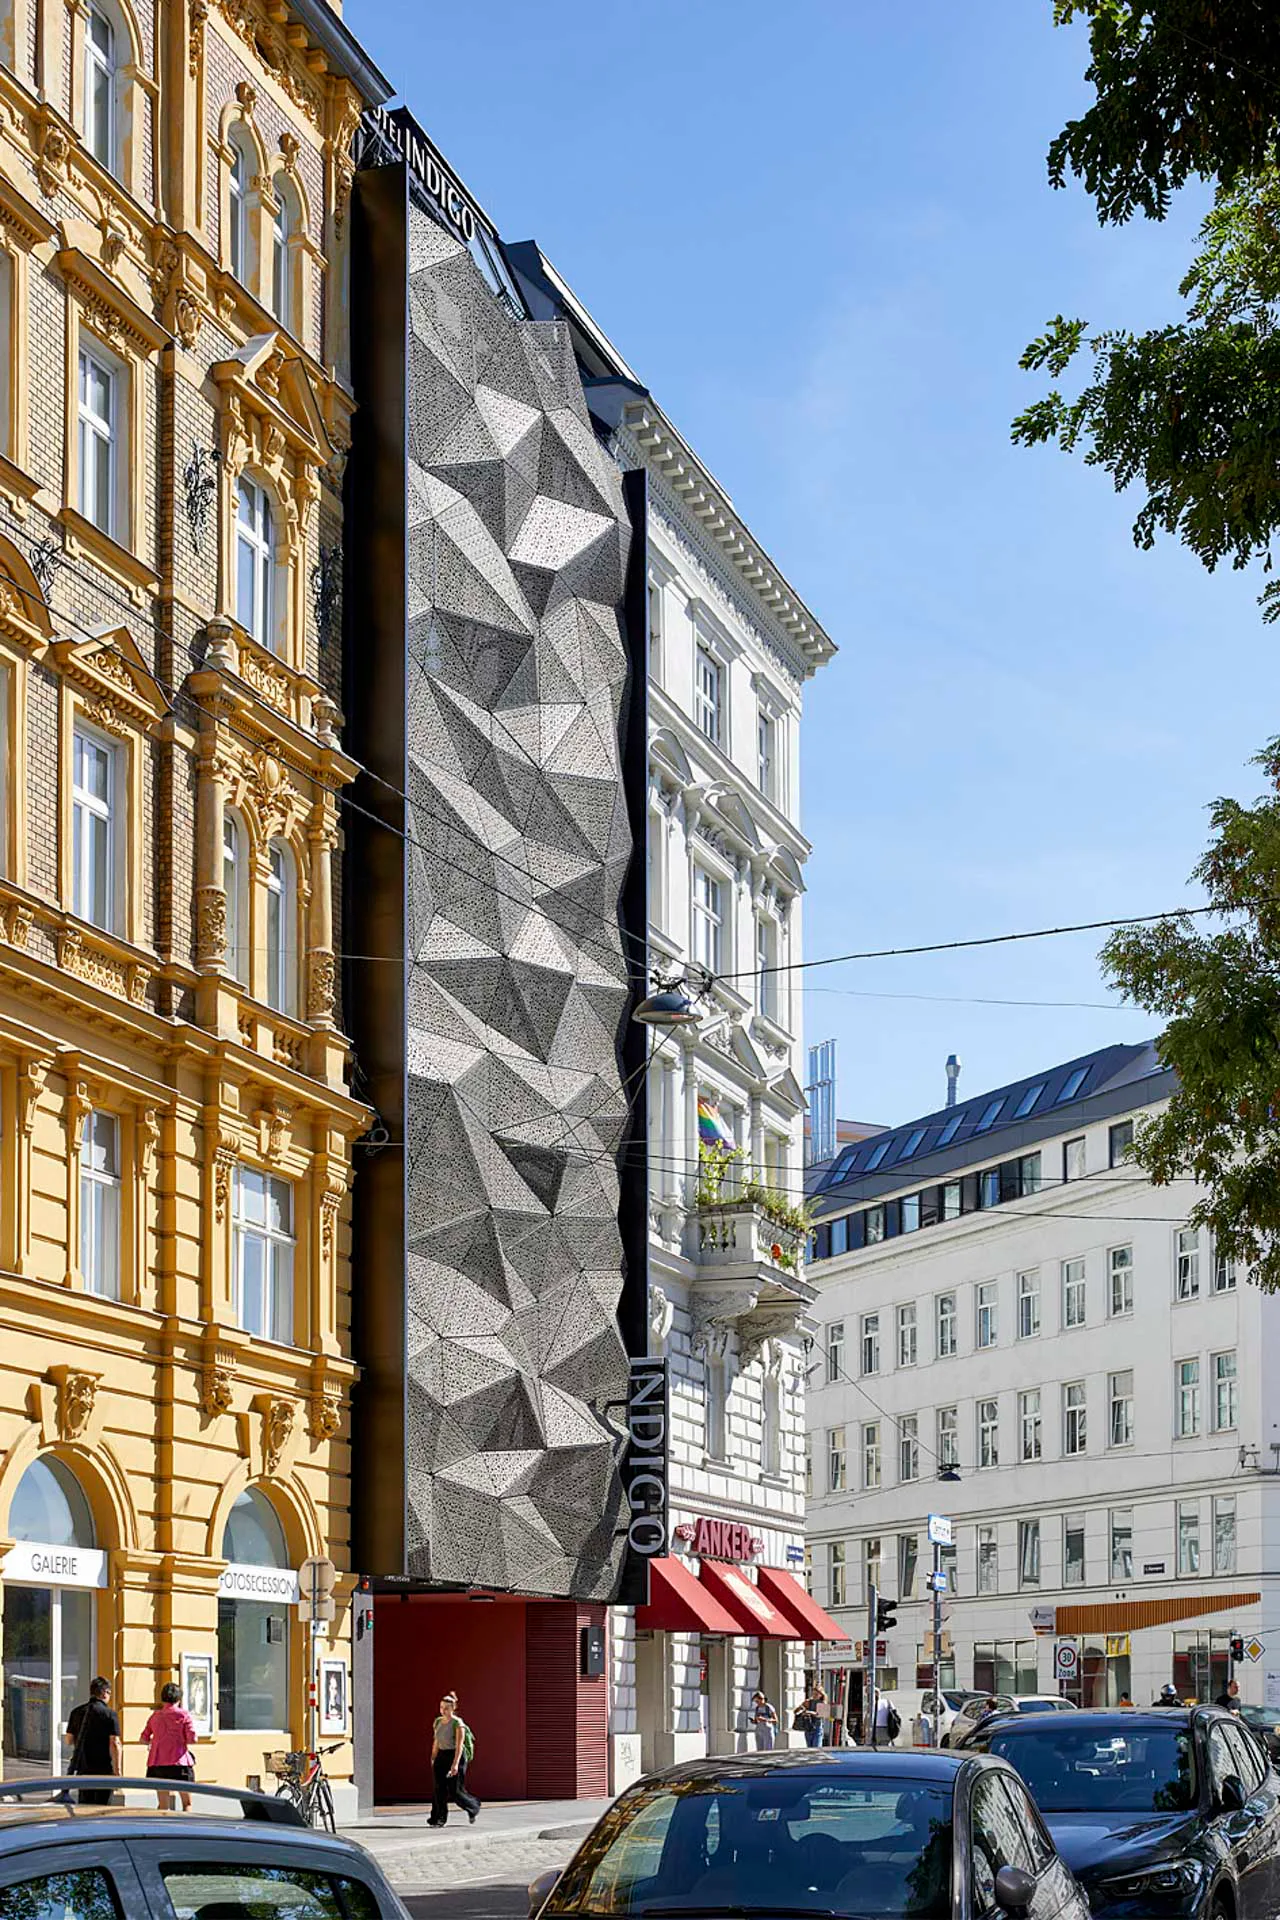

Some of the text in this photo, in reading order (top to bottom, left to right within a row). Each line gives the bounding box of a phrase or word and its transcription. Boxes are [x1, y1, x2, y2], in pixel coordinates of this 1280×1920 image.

[372, 104, 475, 241] OTEL INDIGO
[628, 1357, 665, 1554] INDIGO
[694, 1517, 753, 1562] ANKER
[31, 1553, 77, 1576] GALERIE
[1058, 1668, 1076, 1678] Zone
[1061, 1652, 1072, 1663] 30
